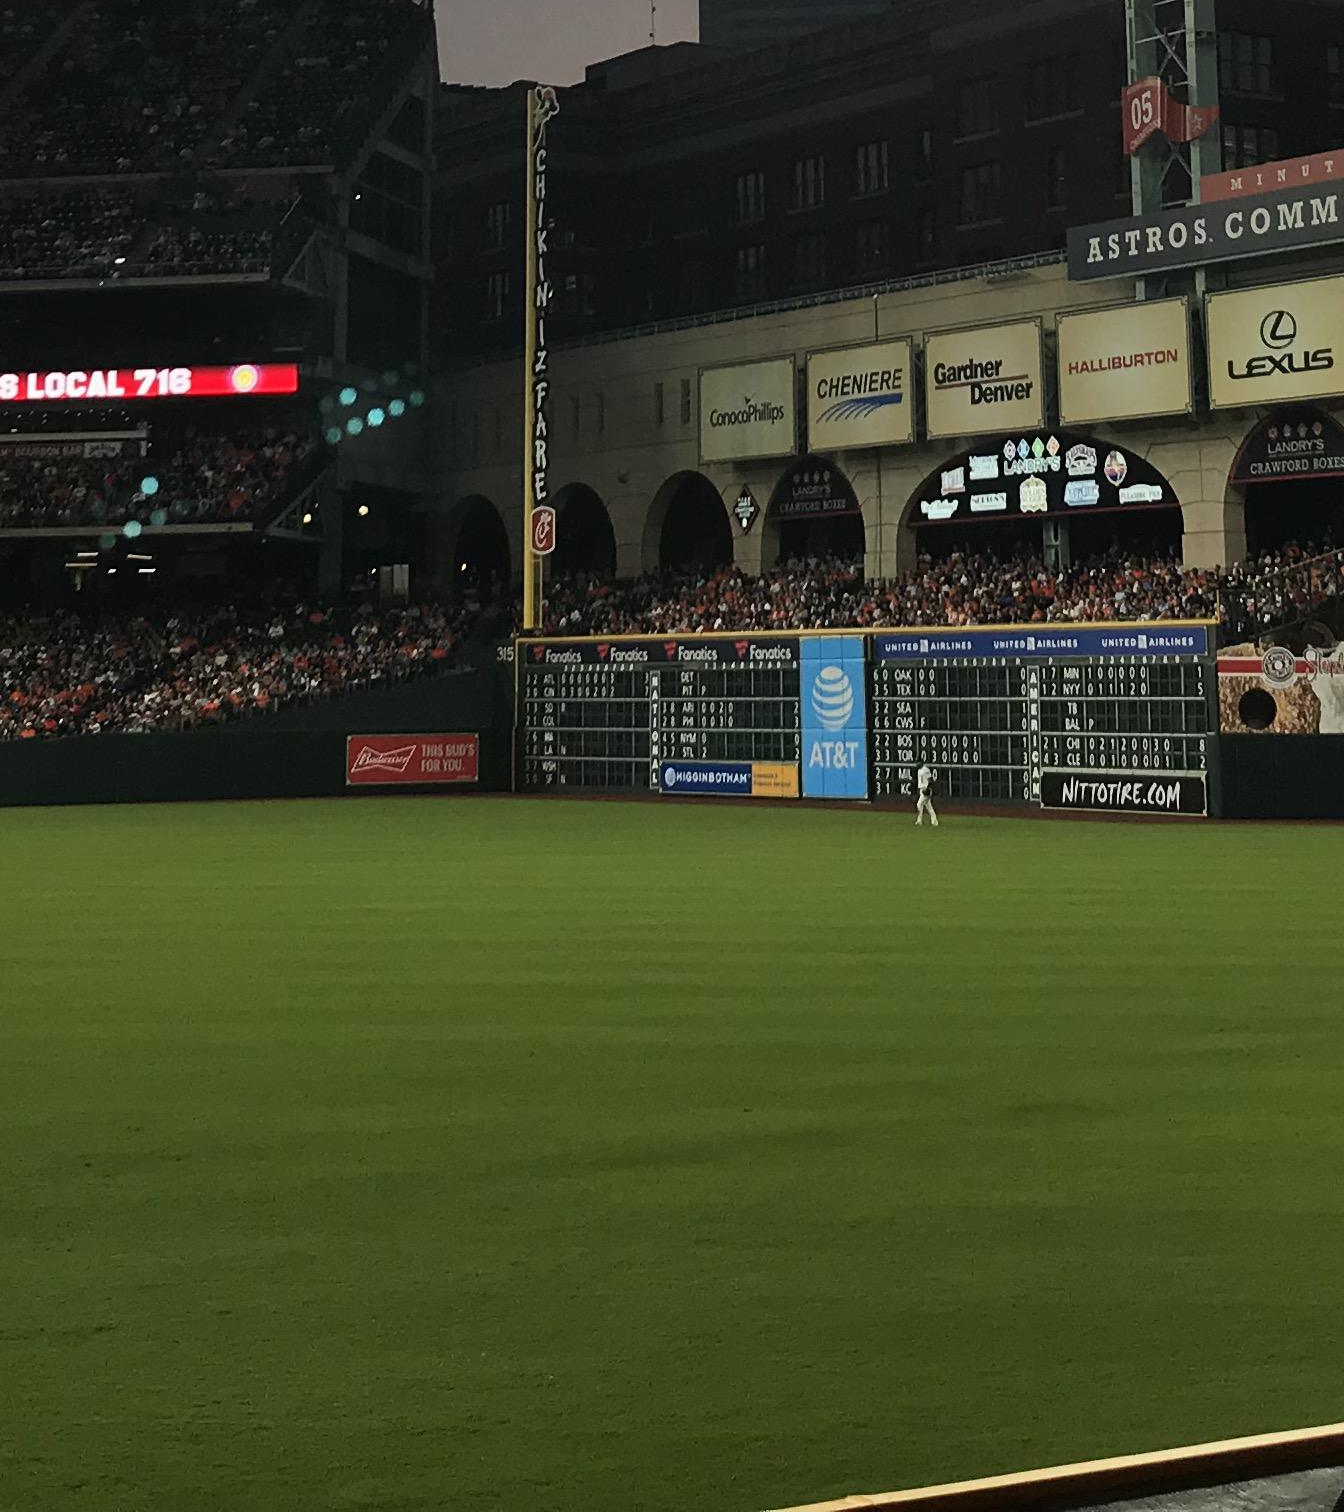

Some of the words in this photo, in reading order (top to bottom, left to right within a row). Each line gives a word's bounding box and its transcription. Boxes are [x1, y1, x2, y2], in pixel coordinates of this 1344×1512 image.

[1131, 90, 1153, 130] 05
[1068, 348, 1178, 375] HALLIBURTON
[1226, 348, 1335, 380] LEXUS
[934, 358, 1003, 385] Gardner
[26, 370, 125, 399] LOCAL
[133, 367, 192, 396] 716
[817, 368, 903, 399] CHENIERE
[970, 380, 1033, 405] Denver
[710, 400, 784, 428] ConocoPhillips
[535, 382, 547, 501] FARE
[1267, 438, 1325, 454] LANDRY'S
[1003, 455, 1061, 476] LANDRY'S
[1250, 458, 1309, 475] CRAWFORD
[885, 642, 918, 652] UNITED
[930, 641, 972, 650] AIRLINES
[994, 640, 1025, 649] UNITED
[1037, 639, 1078, 648] AIRLINES
[1102, 638, 1136, 647] UNITED
[1149, 637, 1194, 646] AIRLINES
[497, 646, 514, 662] 315
[545, 649, 581, 663] Fanatics
[610, 647, 648, 662] Fanatics
[678, 645, 717, 661] Fanatics
[750, 645, 791, 660] Fanatics
[894, 669, 912, 680] OAK
[896, 684, 912, 695] TEX
[1063, 683, 1080, 695] NYY
[896, 702, 912, 714] SEA
[1067, 702, 1078, 714] TB
[651, 676, 659, 784] NATIONAL
[1065, 718, 1080, 731] BAL
[897, 734, 913, 747] BOS
[1030, 671, 1039, 795] AMERICAN
[421, 744, 443, 758] THIS
[1066, 738, 1080, 750] CHI
[357, 751, 409, 766] Budweiser
[809, 741, 859, 769] AT&T
[1066, 753, 1081, 766] CLE
[421, 759, 441, 772] FOR
[676, 771, 748, 784] HIGGINBOTHAM
[900, 783, 912, 795] KC
[1062, 776, 1181, 810] NITTOTIRE.COM
